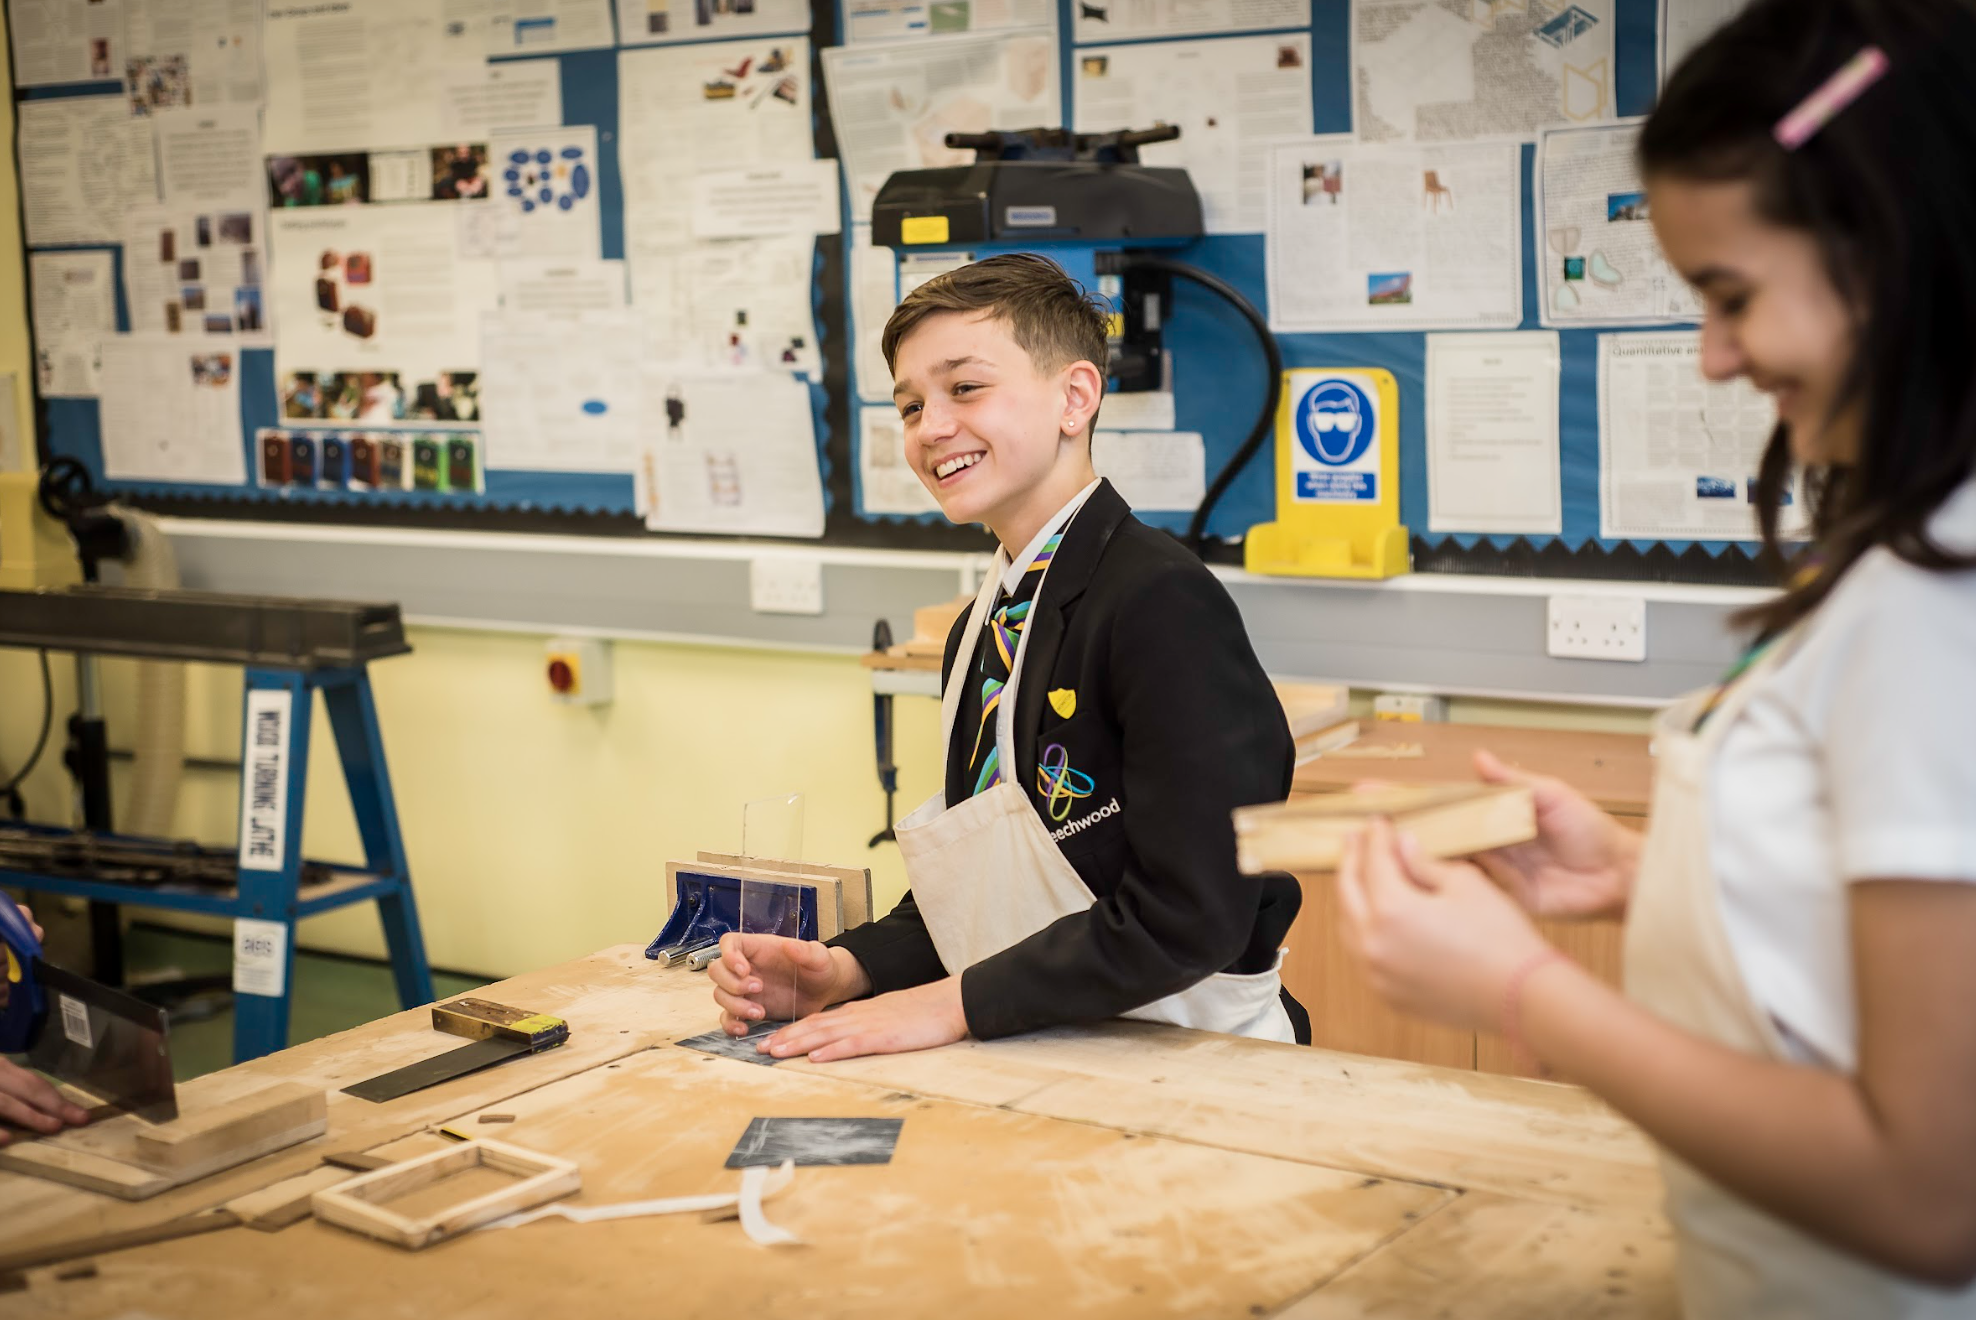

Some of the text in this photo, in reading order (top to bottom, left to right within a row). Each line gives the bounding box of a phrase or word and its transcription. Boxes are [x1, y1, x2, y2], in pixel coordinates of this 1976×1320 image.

[1612, 344, 1683, 356] Quantitative
[250, 817, 275, 857] LATHE
[1050, 797, 1121, 842] eechwood
